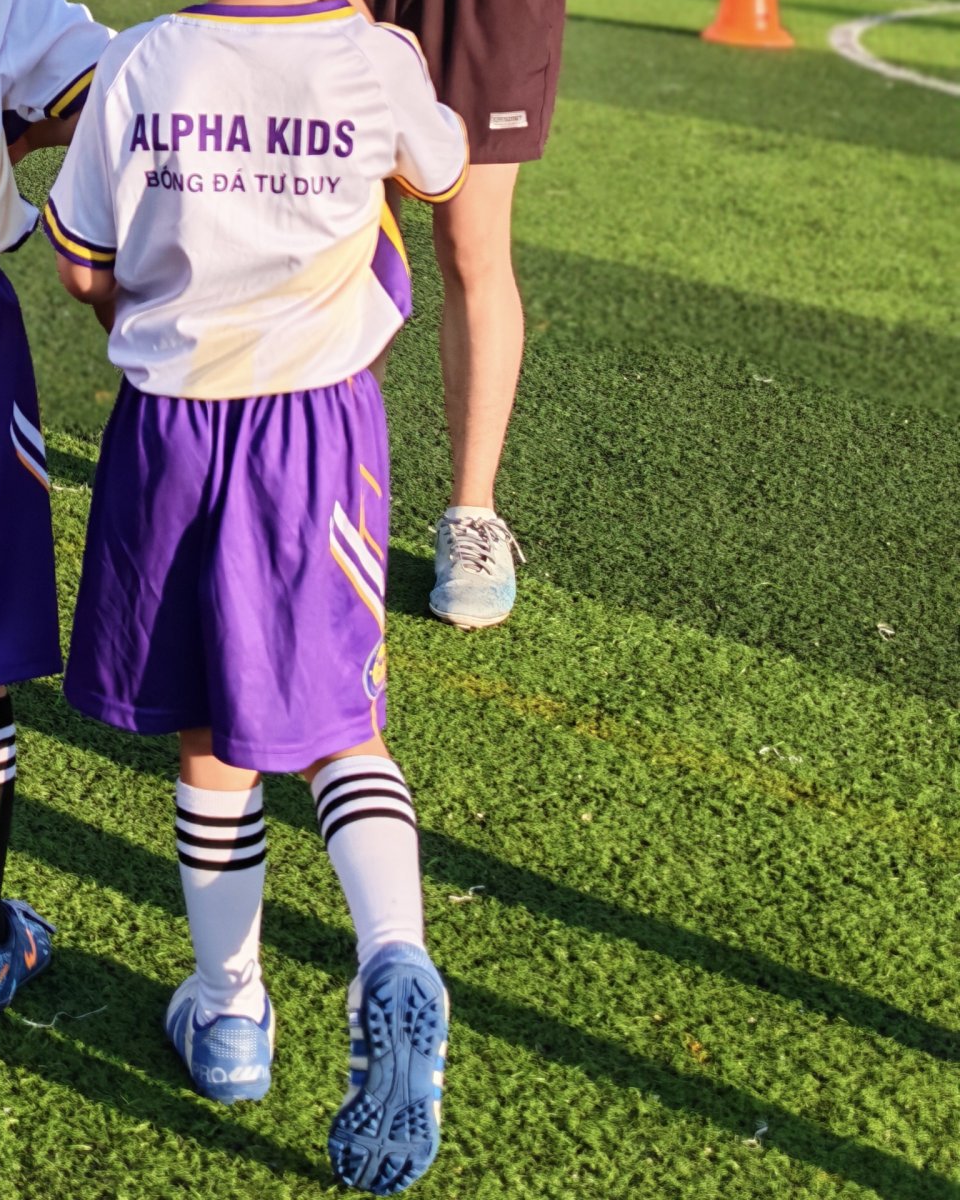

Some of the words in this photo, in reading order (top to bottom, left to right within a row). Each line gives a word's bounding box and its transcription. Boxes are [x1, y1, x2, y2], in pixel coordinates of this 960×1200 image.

[130, 113, 251, 152] ALPHA
[266, 116, 356, 158] KIDS
[144, 166, 203, 193] BÓNG
[212, 168, 246, 193] ĐÁ
[254, 173, 287, 194] TƯ
[294, 175, 341, 196] DUY
